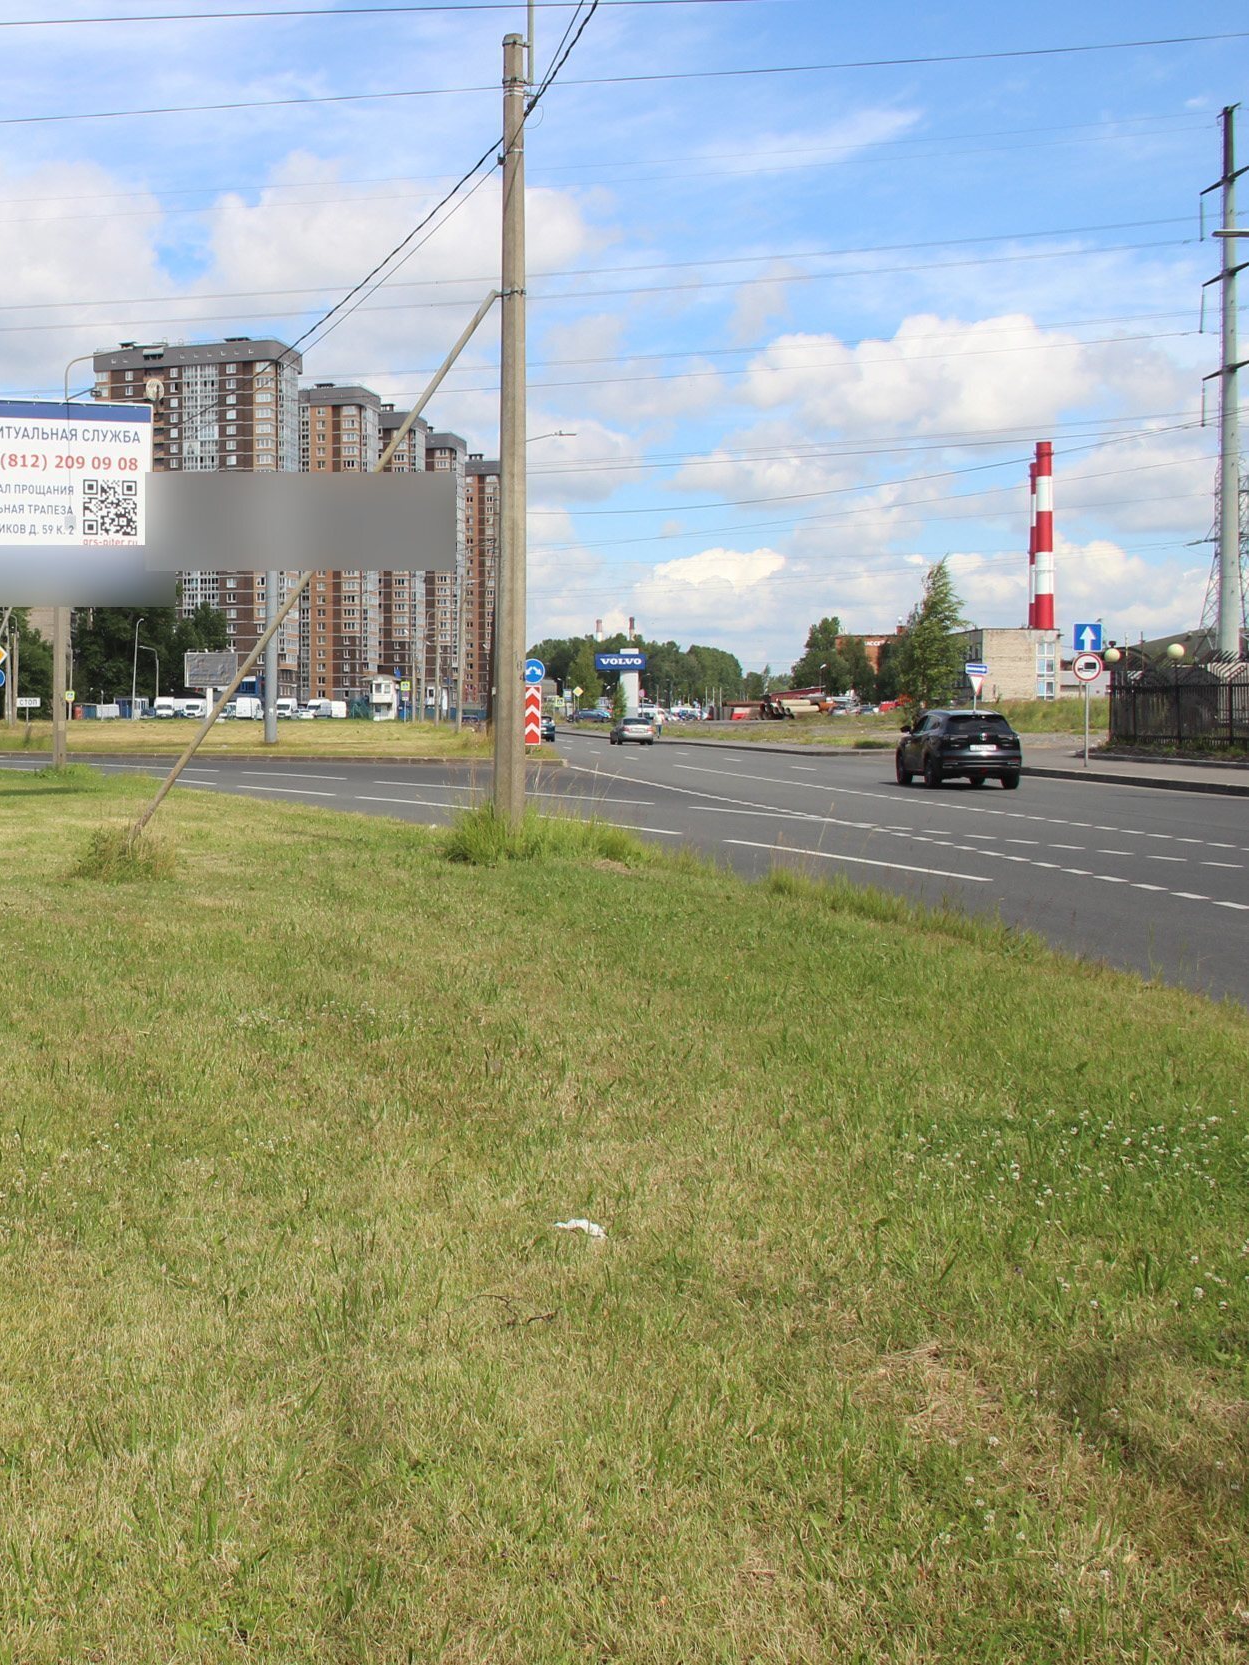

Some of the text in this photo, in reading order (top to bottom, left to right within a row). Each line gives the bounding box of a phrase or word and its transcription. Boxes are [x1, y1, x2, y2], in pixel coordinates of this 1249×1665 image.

[82, 428, 141, 443] СЛУЖБА
[0, 453, 48, 472] (812)
[54, 455, 86, 470] 209
[91, 456, 112, 471] 09
[117, 457, 139, 471] 08
[14, 484, 74, 496] ПРОЩАНИЯ
[28, 504, 73, 515] ТРАПЕЗА
[42, 525, 53, 535] 59
[56, 525, 66, 535] К.
[69, 525, 74, 535] 2
[600, 657, 642, 666] VOLVO
